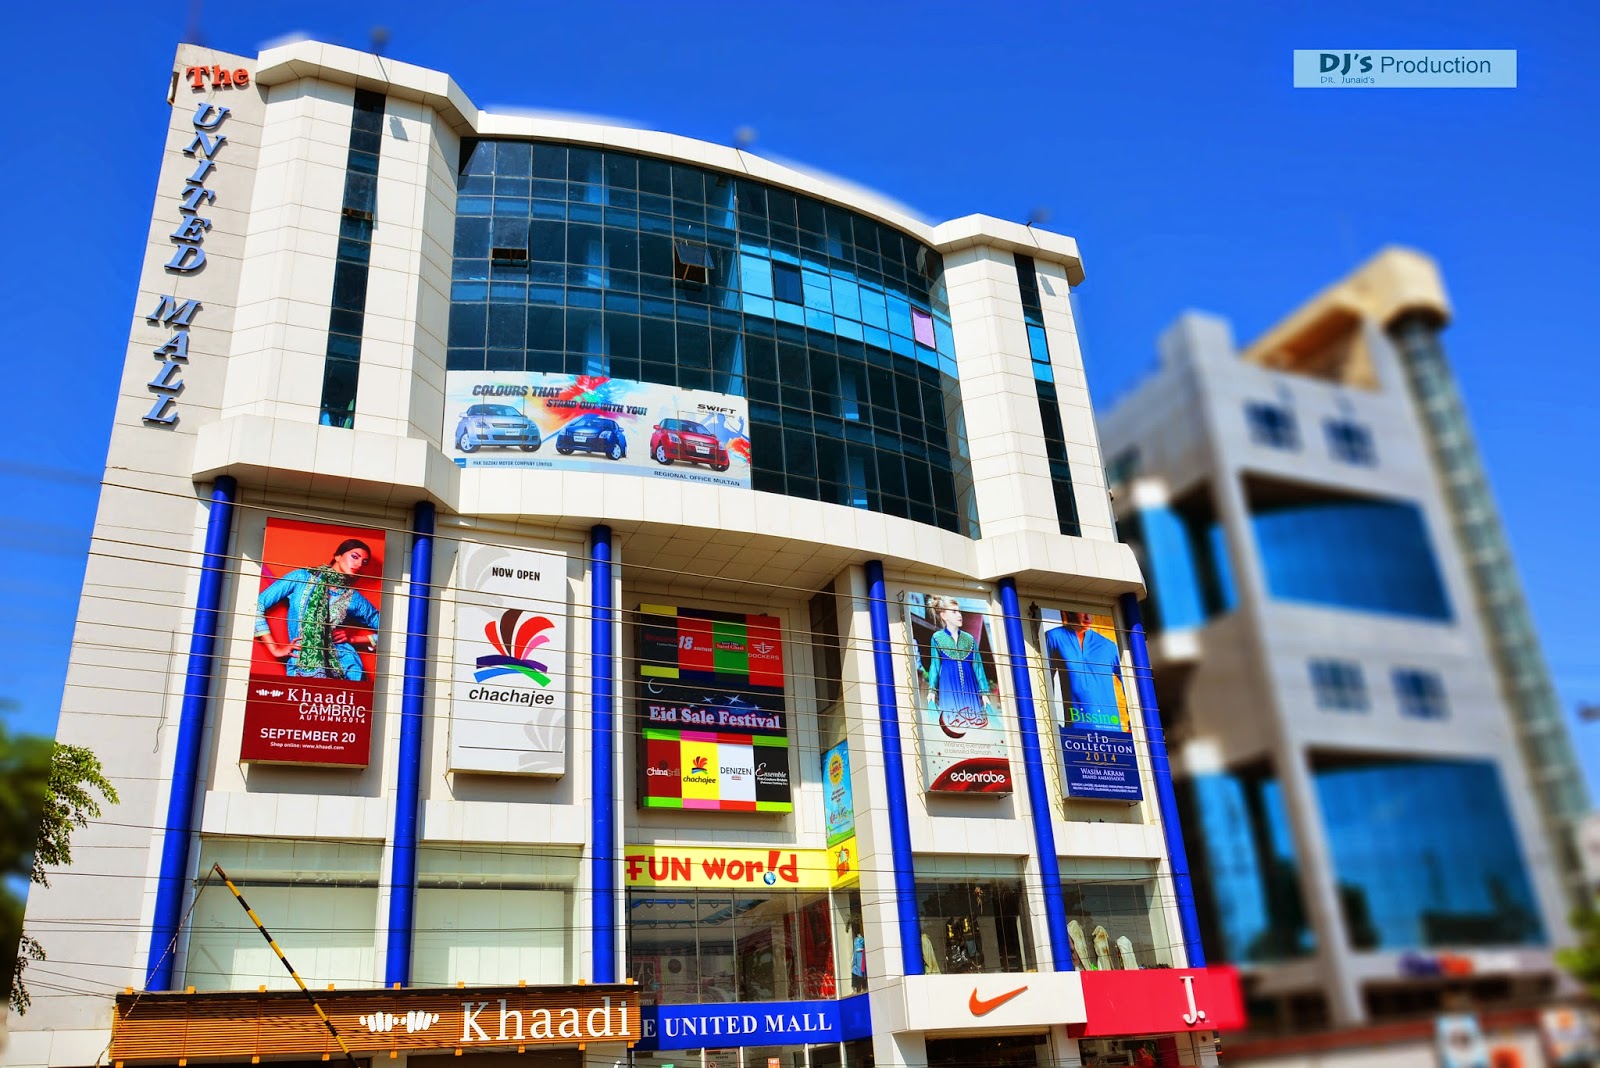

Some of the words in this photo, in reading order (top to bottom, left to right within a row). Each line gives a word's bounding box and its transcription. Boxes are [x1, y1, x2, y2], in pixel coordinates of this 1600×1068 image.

[186, 64, 249, 89] The
[164, 102, 231, 274] UNITED
[142, 294, 202, 425] MALL
[472, 384, 529, 397] COLOURS
[532, 386, 562, 398] THAT
[546, 398, 577, 409] STAND
[579, 402, 598, 411] OUT
[600, 403, 624, 414] WITH
[626, 405, 648, 416] YOU!
[697, 403, 737, 415] SWIFT
[654, 470, 688, 480] REGIONAL
[689, 474, 712, 483] OFFICE
[713, 478, 741, 487] MULTAN
[492, 567, 513, 579] NOW
[516, 569, 541, 582] OPEN
[678, 635, 694, 650] 18
[287, 688, 354, 705] Khaadi
[469, 687, 554, 707] chachajee
[299, 702, 366, 718] CAMBRIC
[649, 705, 676, 721] Eid
[681, 707, 715, 724] Sale
[719, 710, 781, 729] Festival
[260, 727, 338, 742] SEPTEMBER
[341, 732, 356, 743] 20
[1065, 740, 1133, 754] COLLECTION
[1085, 751, 1117, 763] 2014
[720, 766, 752, 776] DENIZEN
[755, 762, 787, 778] Ensemble
[950, 769, 1006, 783] edenrobe
[1080, 767, 1102, 776] WASIM
[1103, 769, 1125, 777] AKRAM
[683, 774, 716, 785] chachajee
[625, 854, 691, 882] FUN
[460, 996, 631, 1042] Khaadi
[664, 1015, 758, 1037] UNITED
[764, 1012, 832, 1033] MALL
